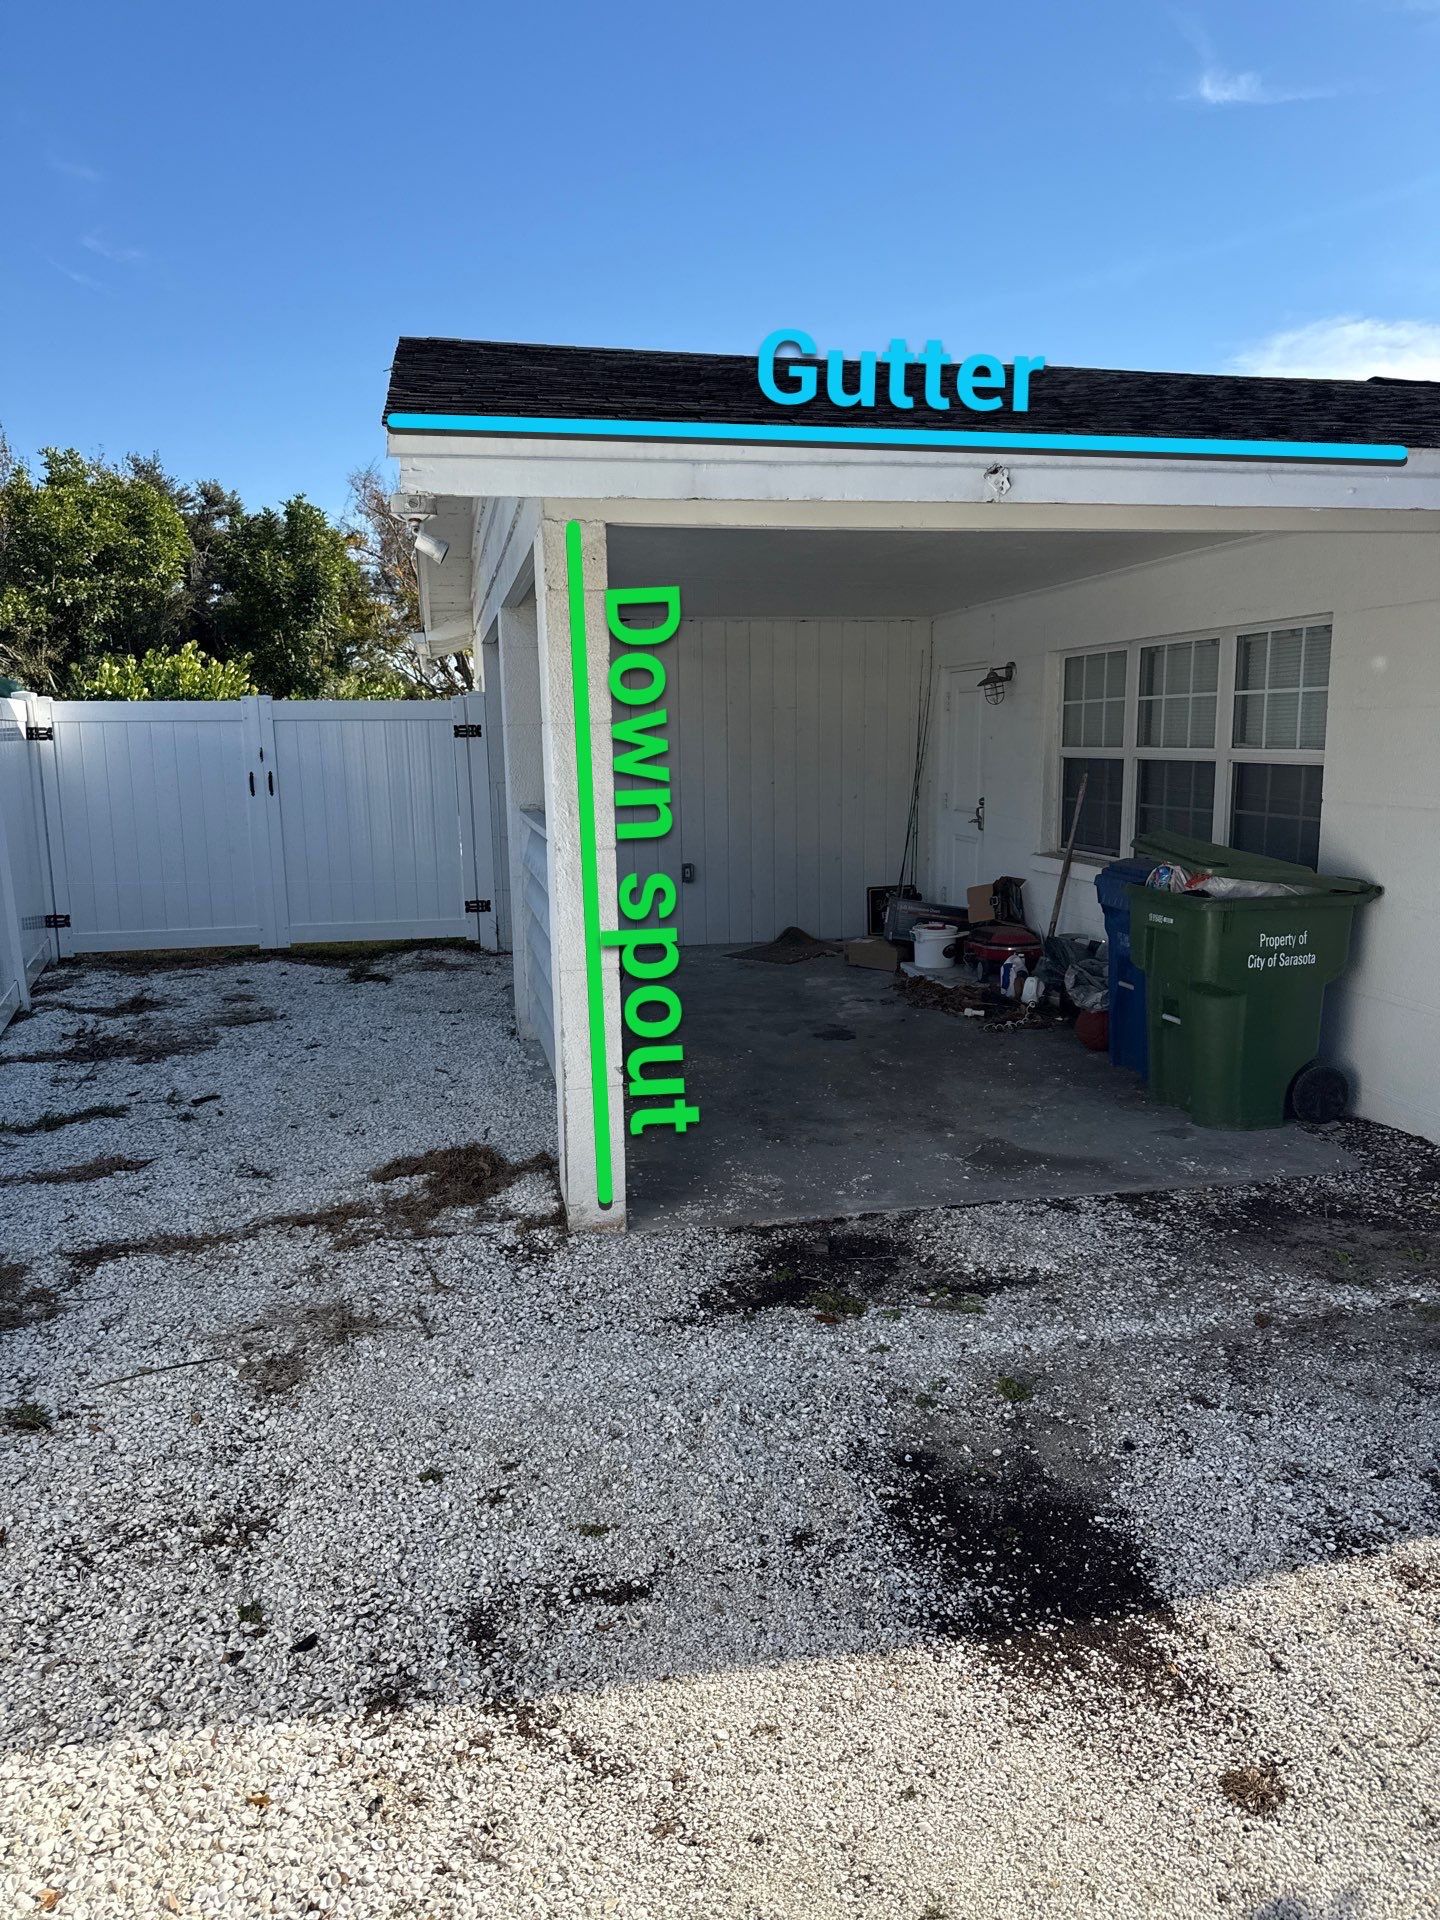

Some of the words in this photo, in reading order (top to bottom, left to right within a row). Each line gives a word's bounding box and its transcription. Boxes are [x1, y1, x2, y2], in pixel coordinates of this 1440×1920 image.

[1259, 933, 1297, 950] Property
[1298, 930, 1308, 945] of
[1247, 954, 1266, 971] City
[1267, 953, 1278, 968] of
[1278, 952, 1316, 967] Sarasota
